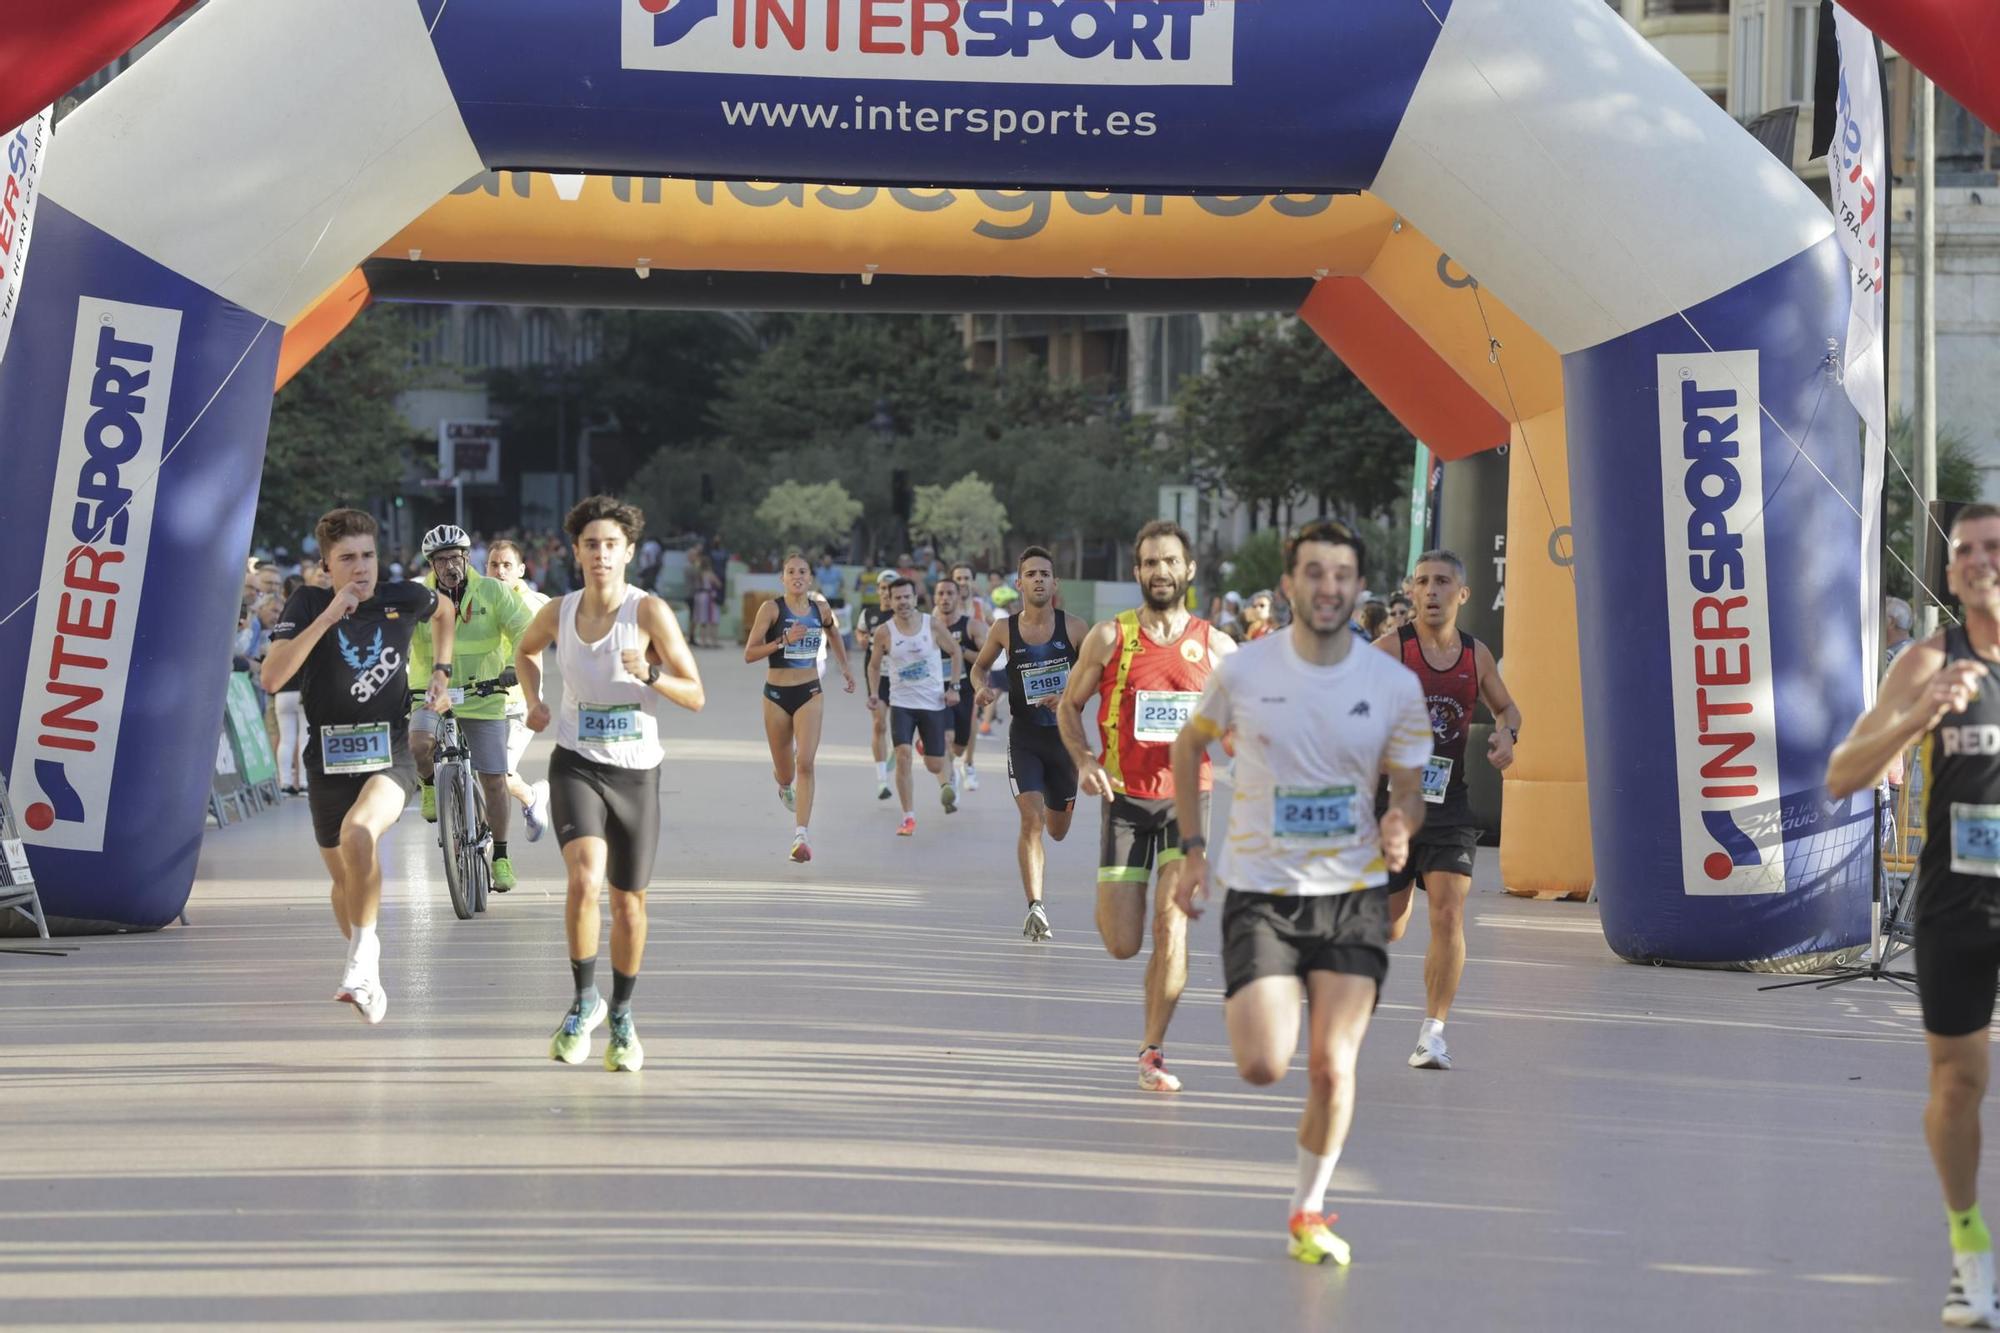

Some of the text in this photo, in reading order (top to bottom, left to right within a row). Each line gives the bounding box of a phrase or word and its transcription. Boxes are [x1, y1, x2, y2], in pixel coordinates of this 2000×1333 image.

[732, 0, 1204, 60] INTERSPORT
[721, 95, 1157, 141] www.intersport.es
[1, 283, 15, 318] THE
[13, 212, 28, 277] HEART
[38, 326, 153, 751] INTERSPORT
[1682, 380, 1757, 797] INTERSPORT
[1031, 676, 1061, 690] 2189
[585, 717, 628, 730] 2446
[1145, 707, 1189, 721] 2233
[328, 736, 379, 753] 2991
[1284, 804, 1340, 822] 2415
